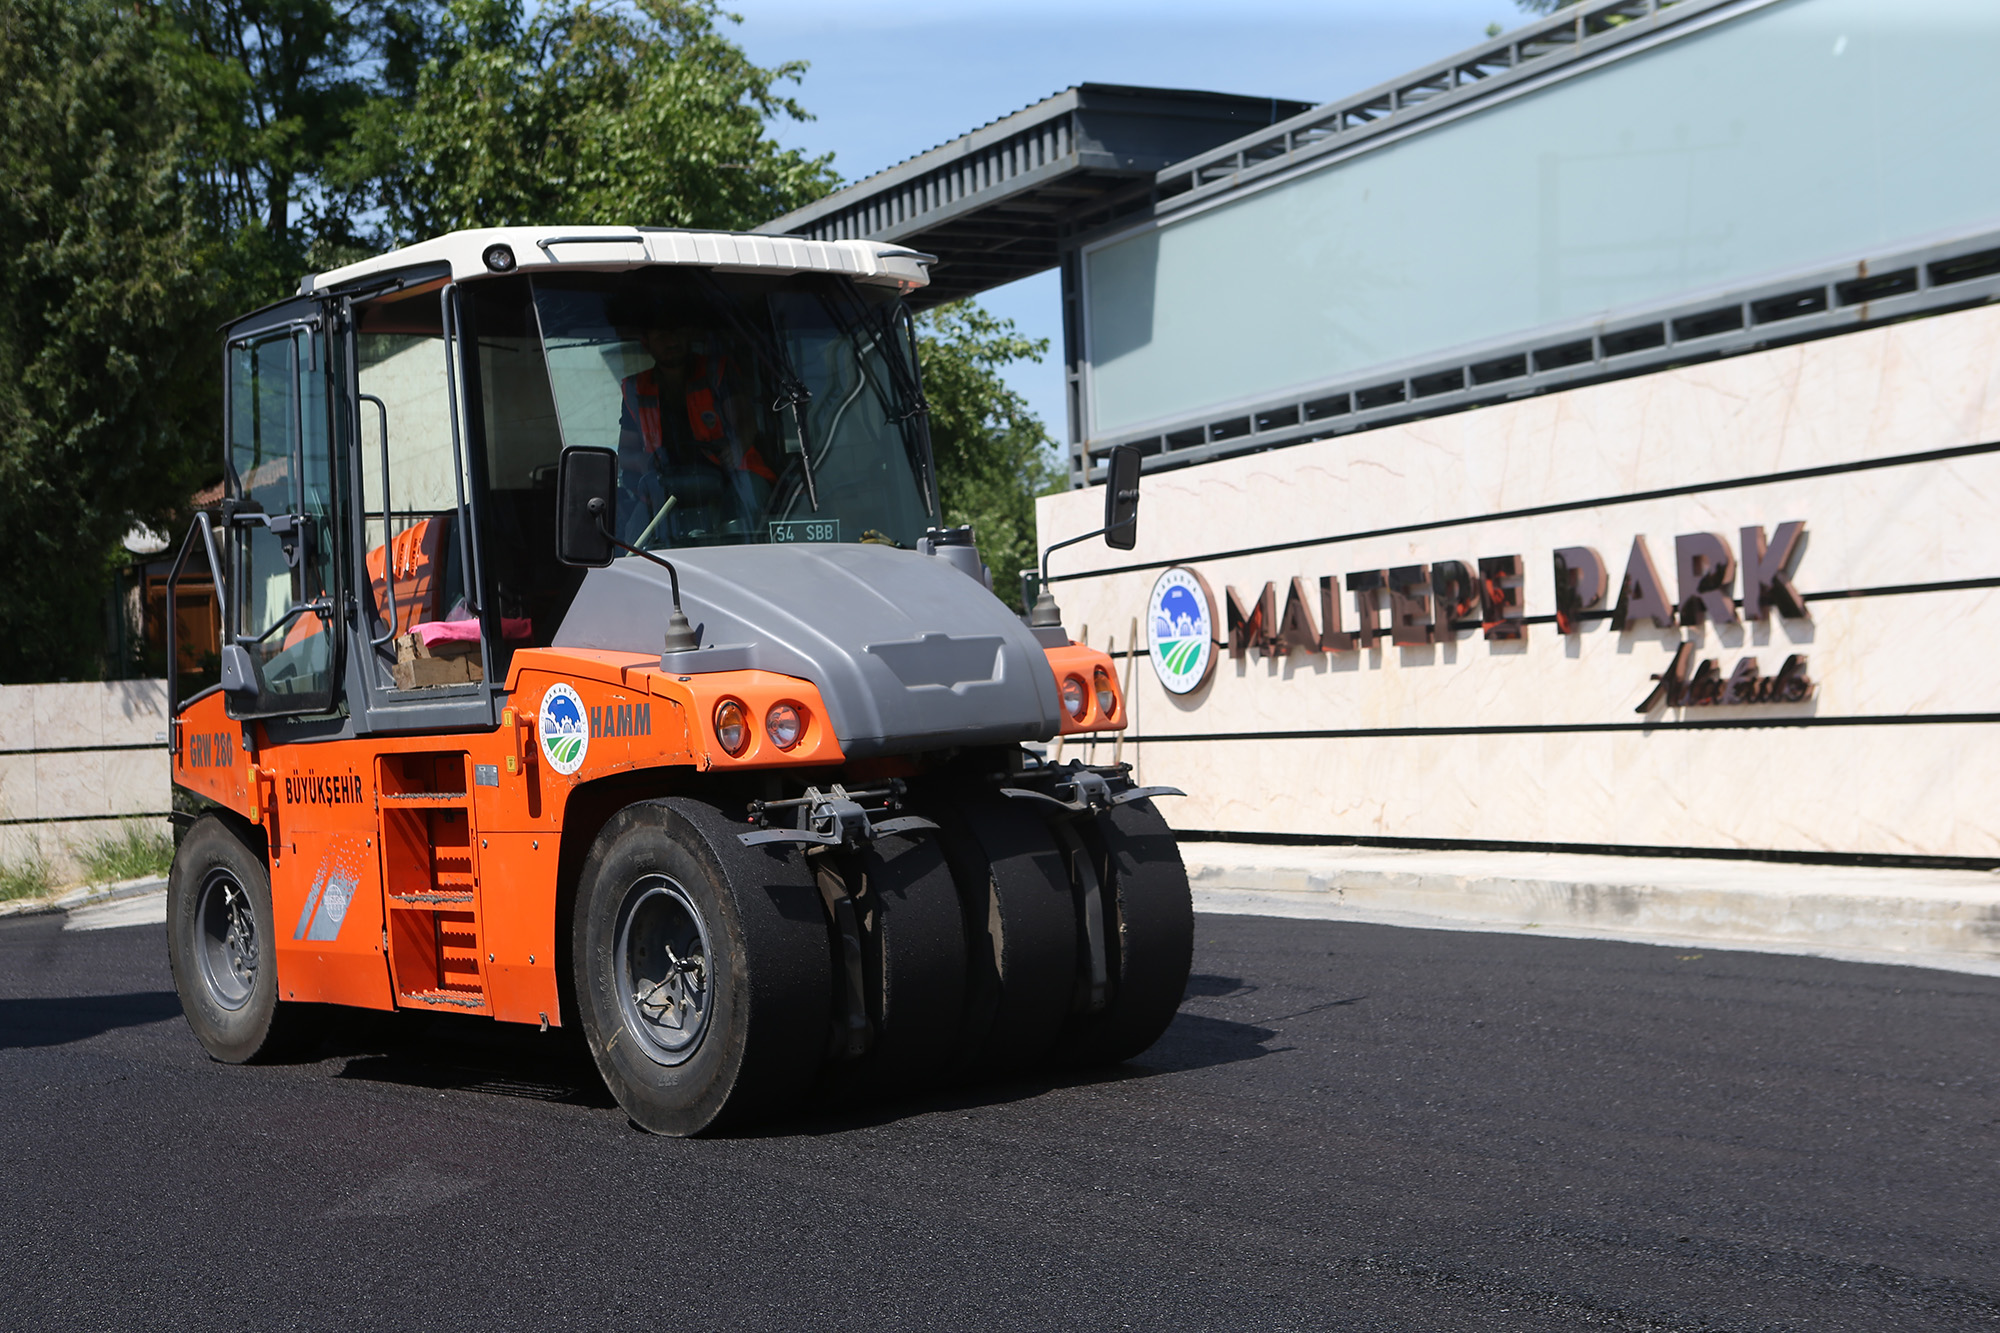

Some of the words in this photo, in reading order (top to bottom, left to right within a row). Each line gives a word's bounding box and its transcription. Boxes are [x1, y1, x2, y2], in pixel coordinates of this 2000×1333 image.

[776, 525, 795, 542] 54
[806, 524, 834, 541] SBB
[1226, 554, 1522, 658] MALTEPE
[1553, 521, 1811, 634] PARK
[590, 703, 651, 738] HAMM
[190, 733, 211, 768] GRW
[214, 732, 233, 767] 280
[285, 766, 363, 808] BÜYÜKŞEHİR
